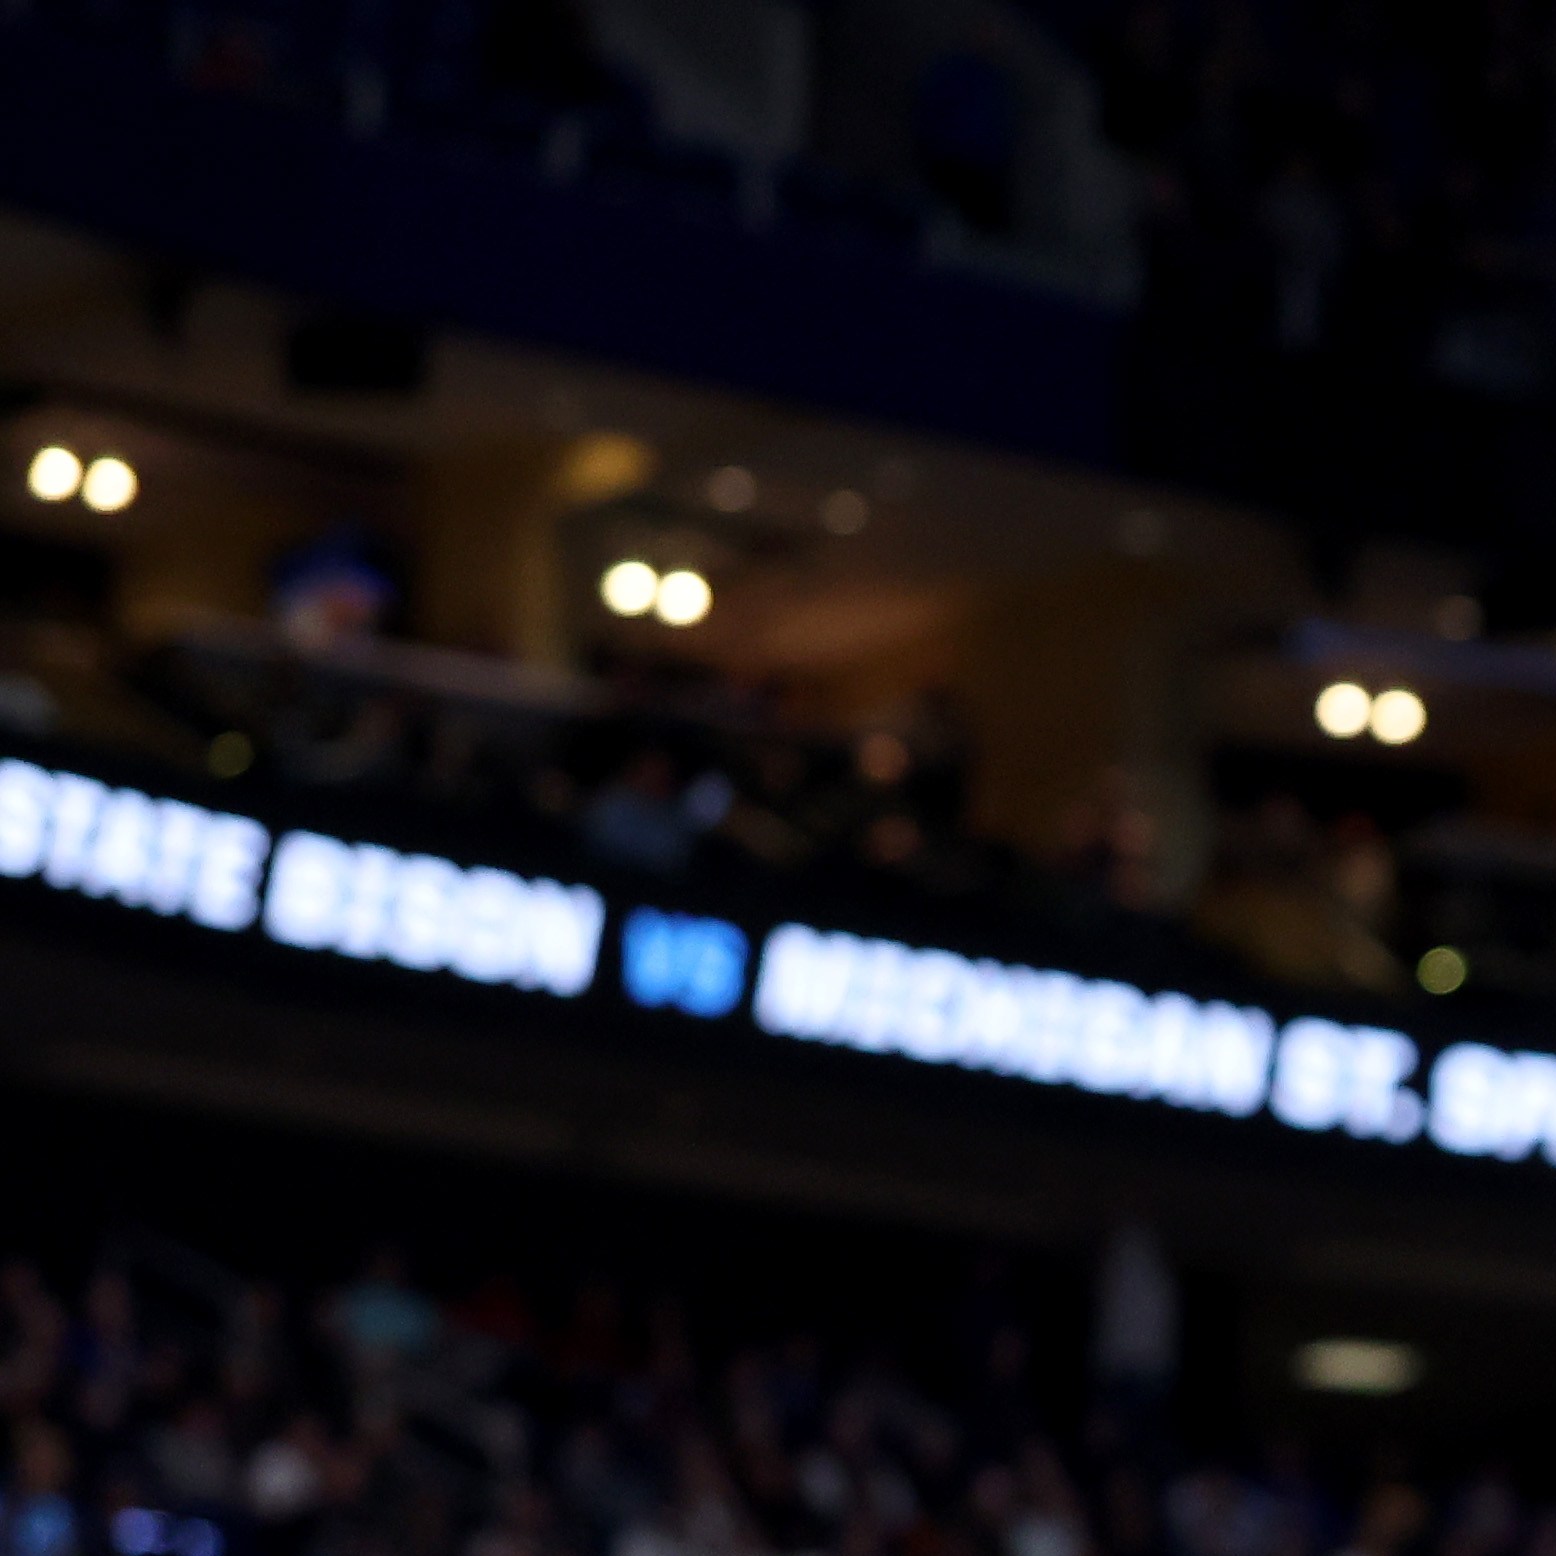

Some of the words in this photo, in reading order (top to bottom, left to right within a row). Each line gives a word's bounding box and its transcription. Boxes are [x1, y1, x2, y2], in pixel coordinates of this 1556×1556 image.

[0, 759, 266, 930] STATE
[266, 831, 605, 996] BISON
[754, 924, 1274, 1116] MICHIGAN
